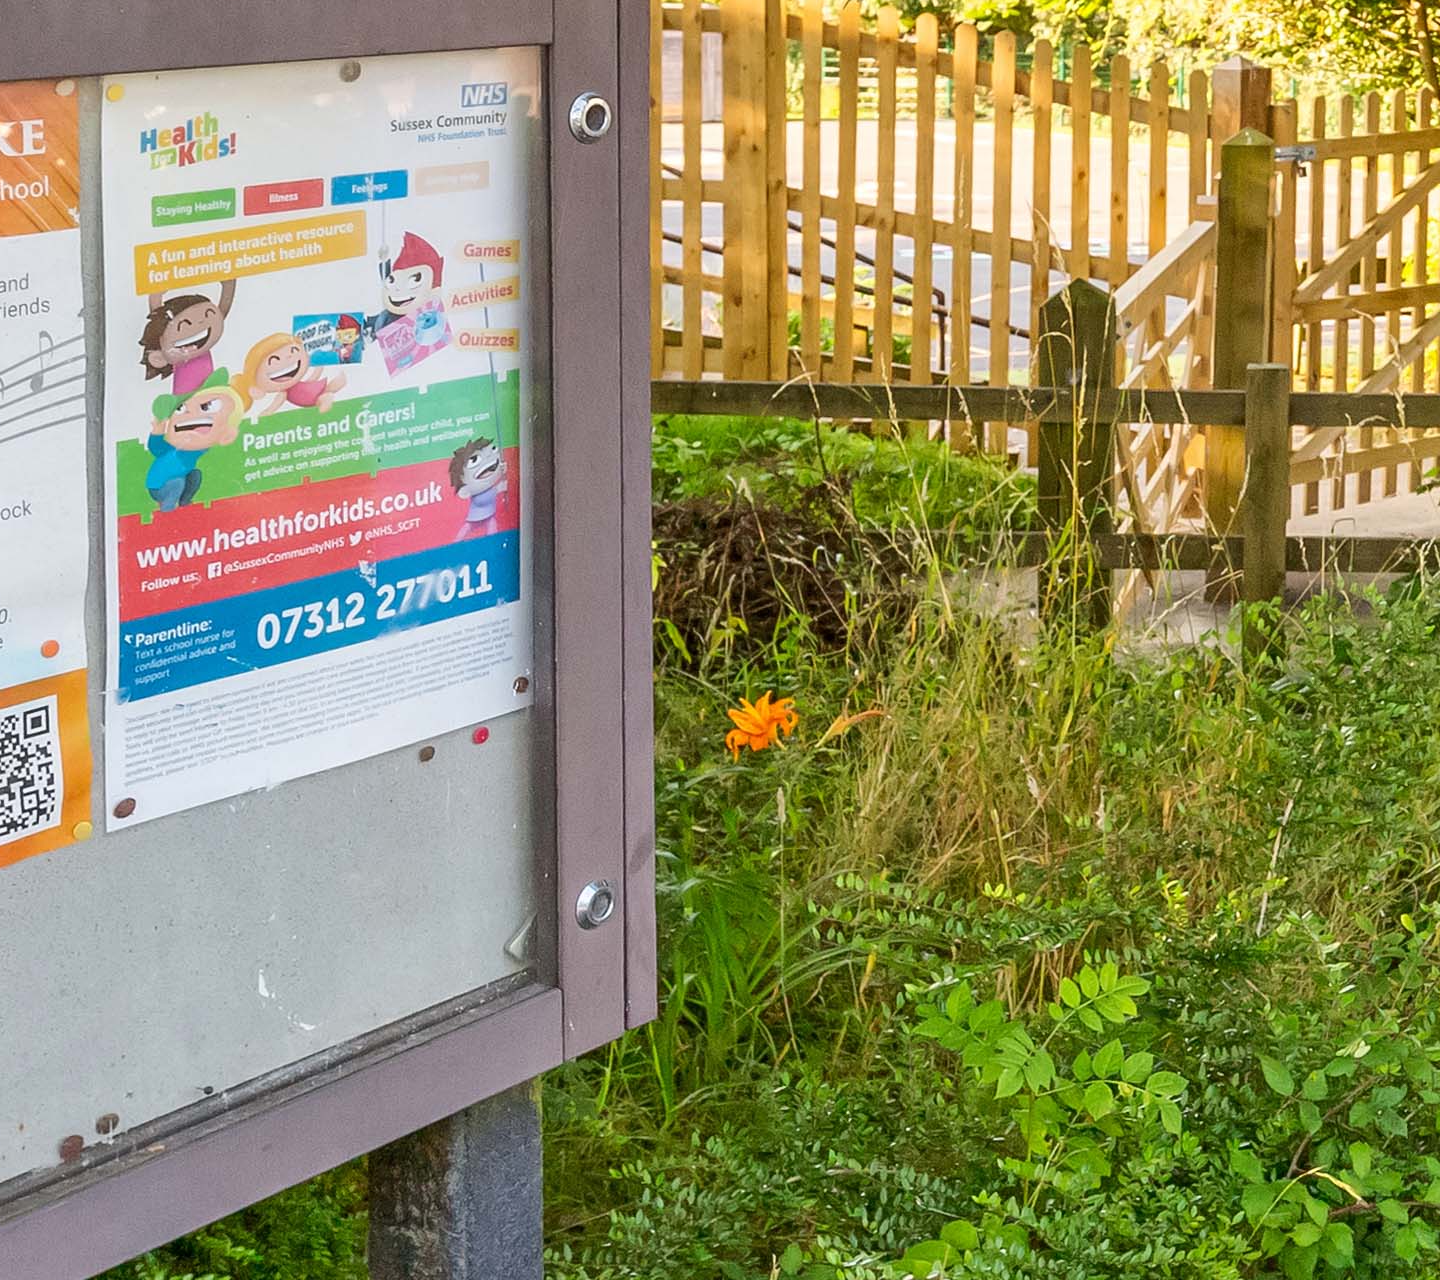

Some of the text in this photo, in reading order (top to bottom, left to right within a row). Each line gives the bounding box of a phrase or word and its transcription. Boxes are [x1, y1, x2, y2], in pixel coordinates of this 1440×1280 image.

[463, 83, 505, 106] NHS
[140, 111, 218, 154] Health
[391, 110, 507, 132] Sussex Community
[418, 128, 507, 142] NHS Foundation Trust
[154, 154, 174, 165] for
[179, 132, 236, 167] Kids!
[156, 199, 231, 217] Staying Healthy
[269, 192, 299, 203] Illness
[148, 222, 354, 266] A fun and interactive resource
[464, 243, 512, 257] Games
[148, 243, 322, 283] for learning about health
[451, 285, 513, 307] Activities
[459, 332, 515, 347] Quizzes
[243, 403, 416, 452] Parents and Carers!
[244, 457, 257, 467] As
[258, 453, 278, 464] well
[280, 452, 290, 460] as
[293, 442, 333, 458] enjoying
[335, 439, 350, 449] the
[388, 428, 407, 438] with
[409, 425, 429, 437] your
[457, 415, 473, 426] you
[474, 413, 489, 422] can
[244, 471, 261, 483] get
[263, 462, 295, 477] advice
[297, 461, 308, 471] on
[310, 450, 359, 468] supporting
[384, 440, 411, 454] health
[413, 436, 429, 446] and
[136, 481, 443, 569] www.healthforkids.co.uk
[141, 576, 180, 593] Follow
[224, 537, 345, 575] @SussexCommunityNHS
[256, 560, 493, 650] 07312 277011
[135, 619, 213, 648] Parentline:
[136, 649, 154, 659] Text
[164, 639, 193, 653] school
[195, 633, 220, 645] nurse
[222, 629, 235, 638] for
[135, 640, 236, 672] confidential advice and
[135, 669, 170, 685] support
